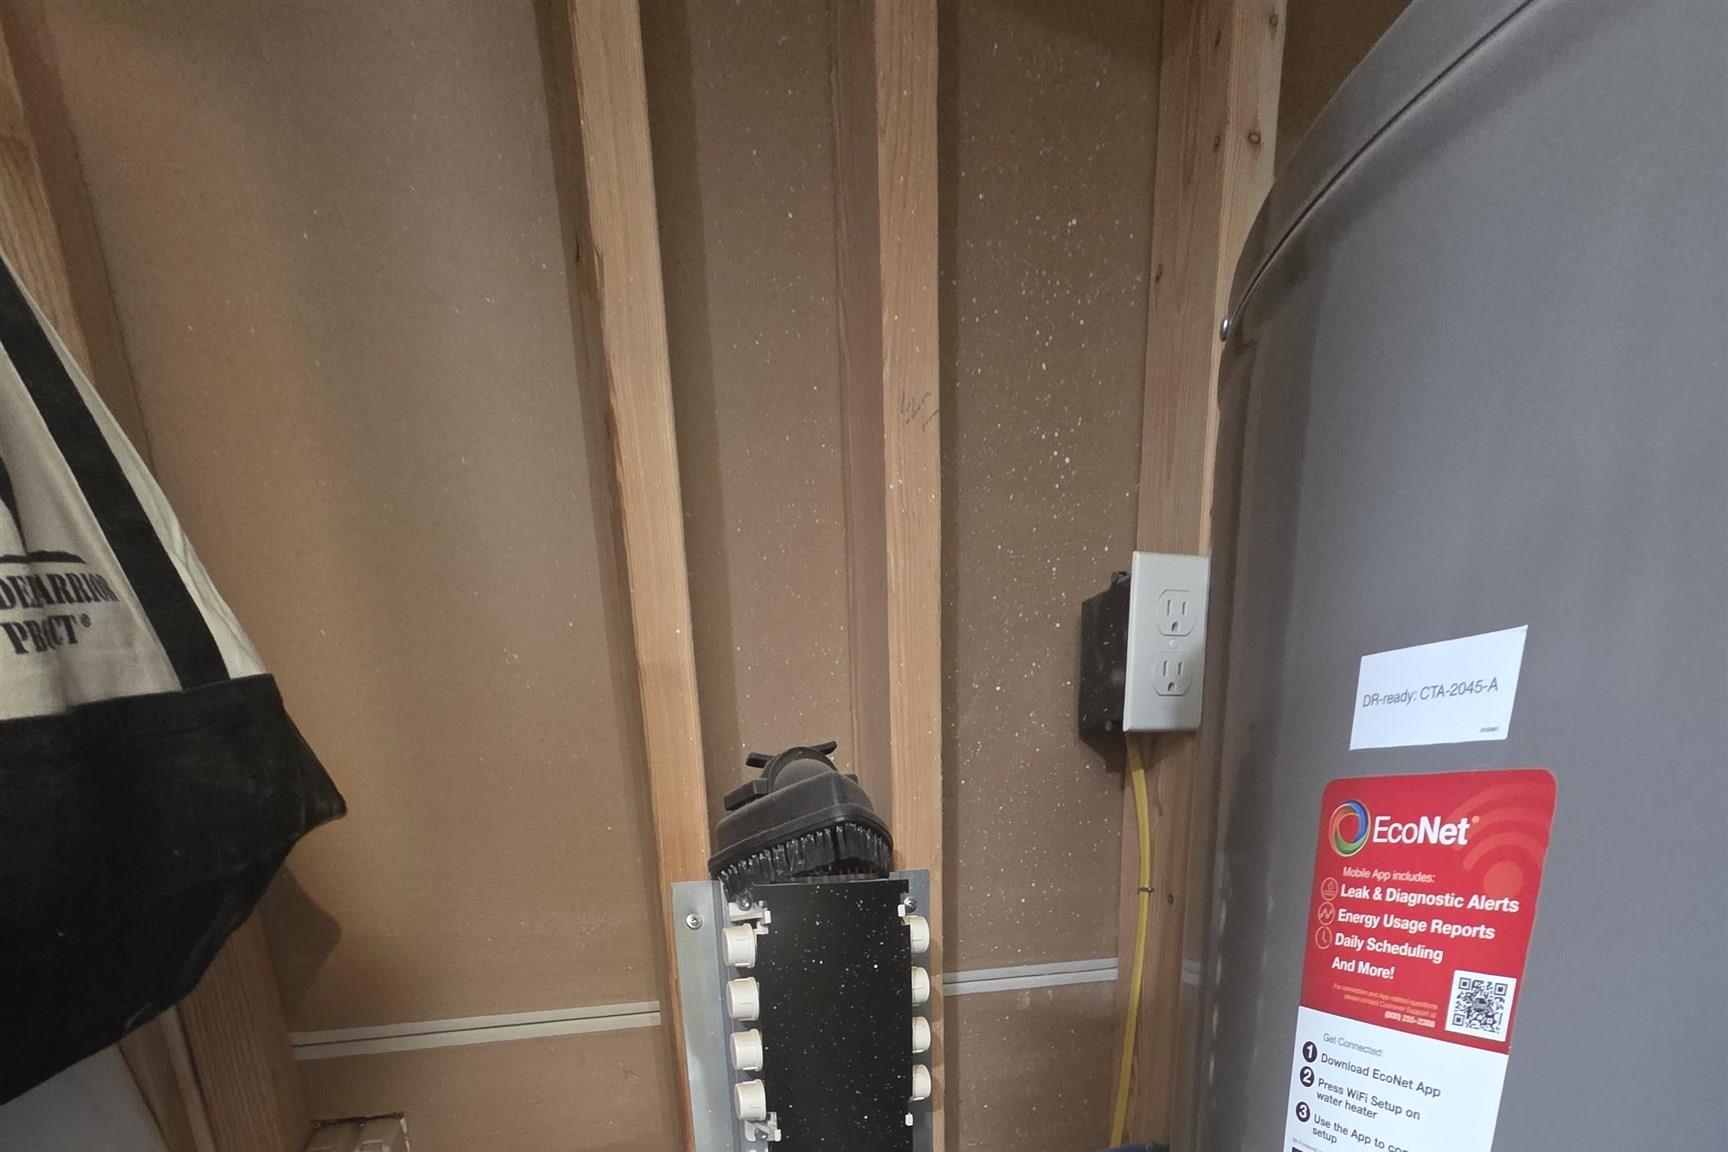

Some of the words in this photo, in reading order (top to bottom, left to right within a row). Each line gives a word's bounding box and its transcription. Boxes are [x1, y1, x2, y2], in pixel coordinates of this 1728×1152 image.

[1362, 689, 1417, 708] DR-ready:
[1419, 677, 1499, 701] CTA-2045-A
[1372, 815, 1470, 845] EcoNet
[1343, 866, 1370, 878] Mobile
[1372, 869, 1391, 882] App
[1392, 870, 1436, 883] includes:
[1340, 884, 1370, 900] Leak
[1372, 886, 1383, 901] &
[1386, 888, 1464, 909] Diagnostic
[1467, 894, 1520, 913] Alerts
[1338, 909, 1380, 928] Energy
[1383, 914, 1427, 934] Usage
[1430, 919, 1496, 940] Reports
[1335, 933, 1364, 952] Daily
[1366, 937, 1444, 964] Scheduling
[1331, 957, 1355, 972] And
[1357, 961, 1395, 980] More!
[1323, 1033, 1336, 1045] Get
[1338, 1037, 1384, 1057] Connected:
[1321, 1053, 1369, 1077] Download
[1372, 1069, 1414, 1090] EcoNet
[1416, 1082, 1441, 1098] App
[1316, 1092, 1342, 1107] water
[1345, 1098, 1378, 1119] heater
[1318, 1078, 1343, 1095] Press
[1346, 1088, 1368, 1103] WiFi
[1370, 1096, 1402, 1116] Setup
[1406, 1108, 1421, 1121] on
[1312, 1127, 1338, 1144] setup
[1313, 1114, 1331, 1129] Use
[1333, 1121, 1348, 1136] the
[1351, 1129, 1372, 1145] App
[1374, 1137, 1385, 1149] to
